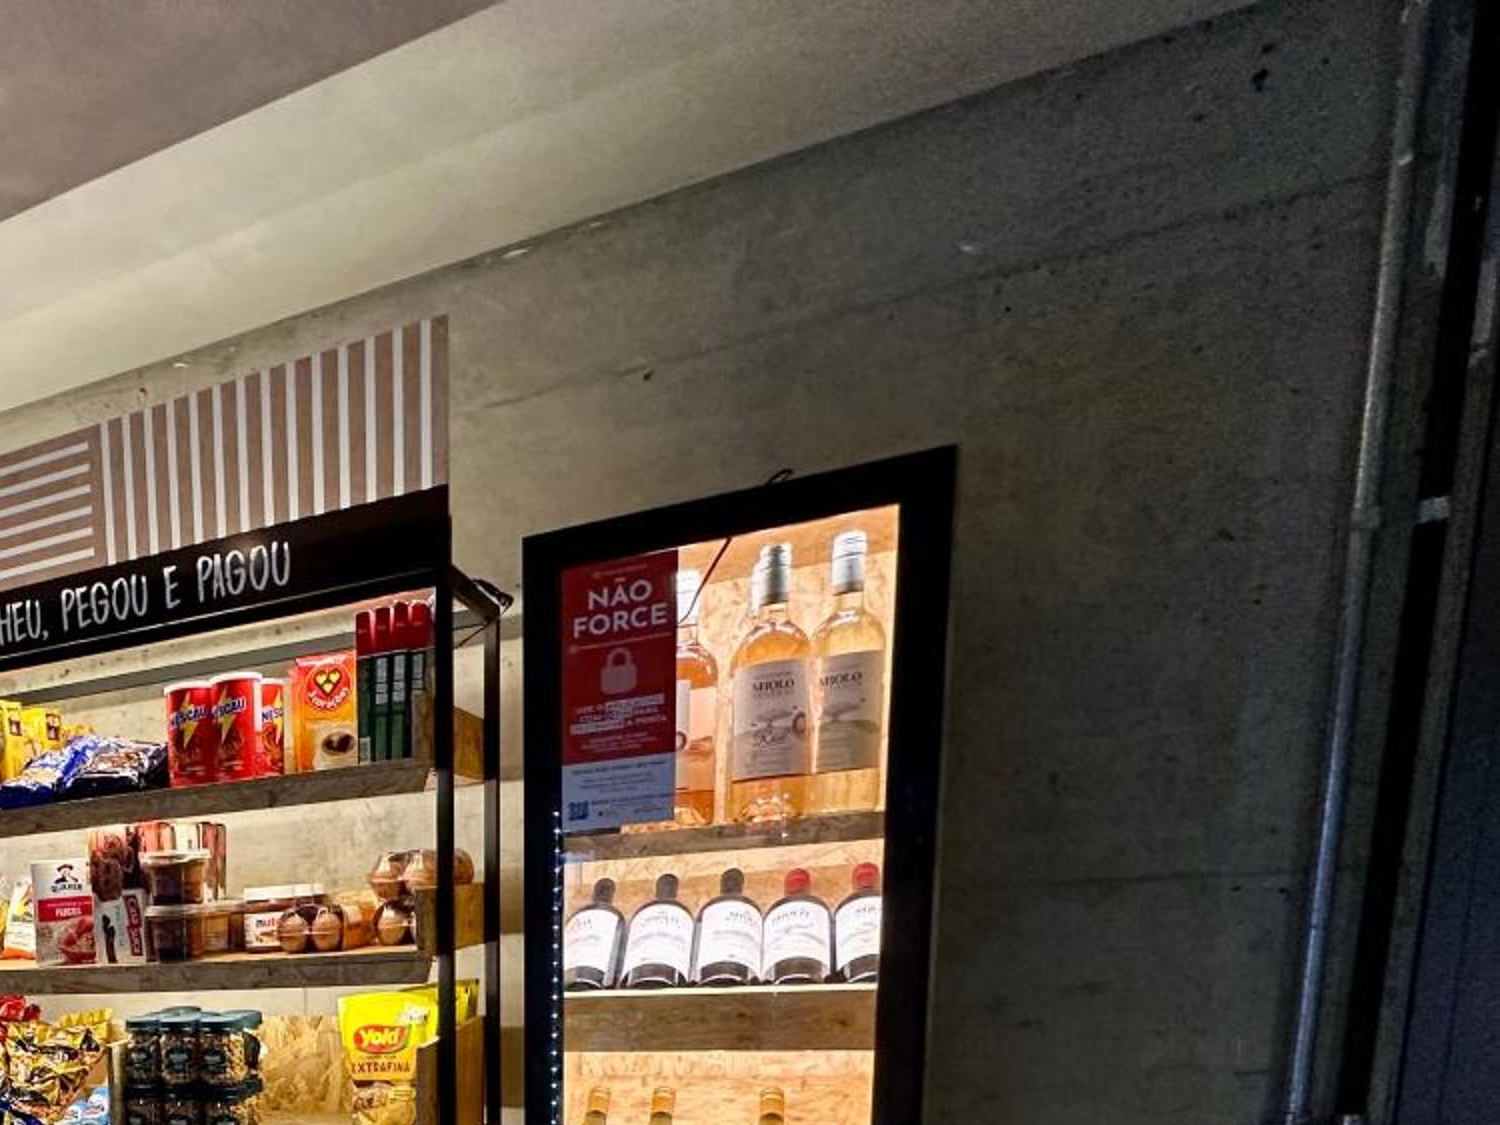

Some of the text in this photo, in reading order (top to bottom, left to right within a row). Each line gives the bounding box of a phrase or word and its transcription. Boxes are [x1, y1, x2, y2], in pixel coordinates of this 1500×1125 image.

[60, 574, 149, 632] PEGOU
[163, 565, 181, 609] E
[197, 541, 291, 603] PAGOU
[588, 577, 653, 610] NÃO
[573, 602, 668, 639] FORCE
